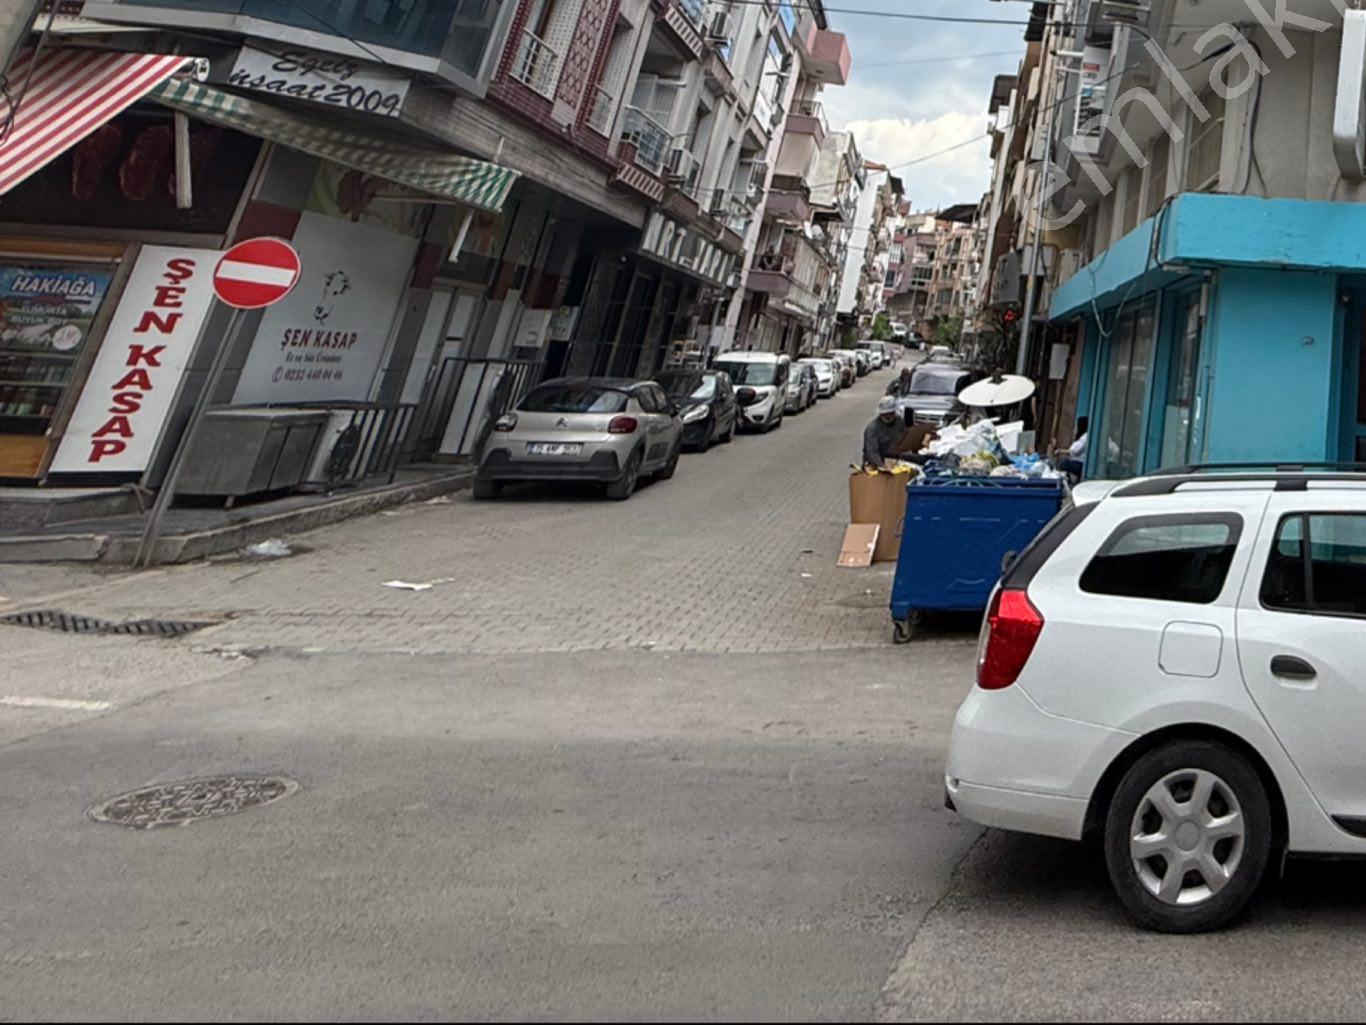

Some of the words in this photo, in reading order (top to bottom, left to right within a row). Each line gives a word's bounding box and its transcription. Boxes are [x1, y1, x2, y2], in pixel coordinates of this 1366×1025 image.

[11, 274, 96, 296] HAKİAĞA
[133, 258, 197, 335] ŞEN
[281, 327, 313, 351] ŞEN
[313, 330, 358, 350] KASAP
[87, 344, 168, 463] KASAP
